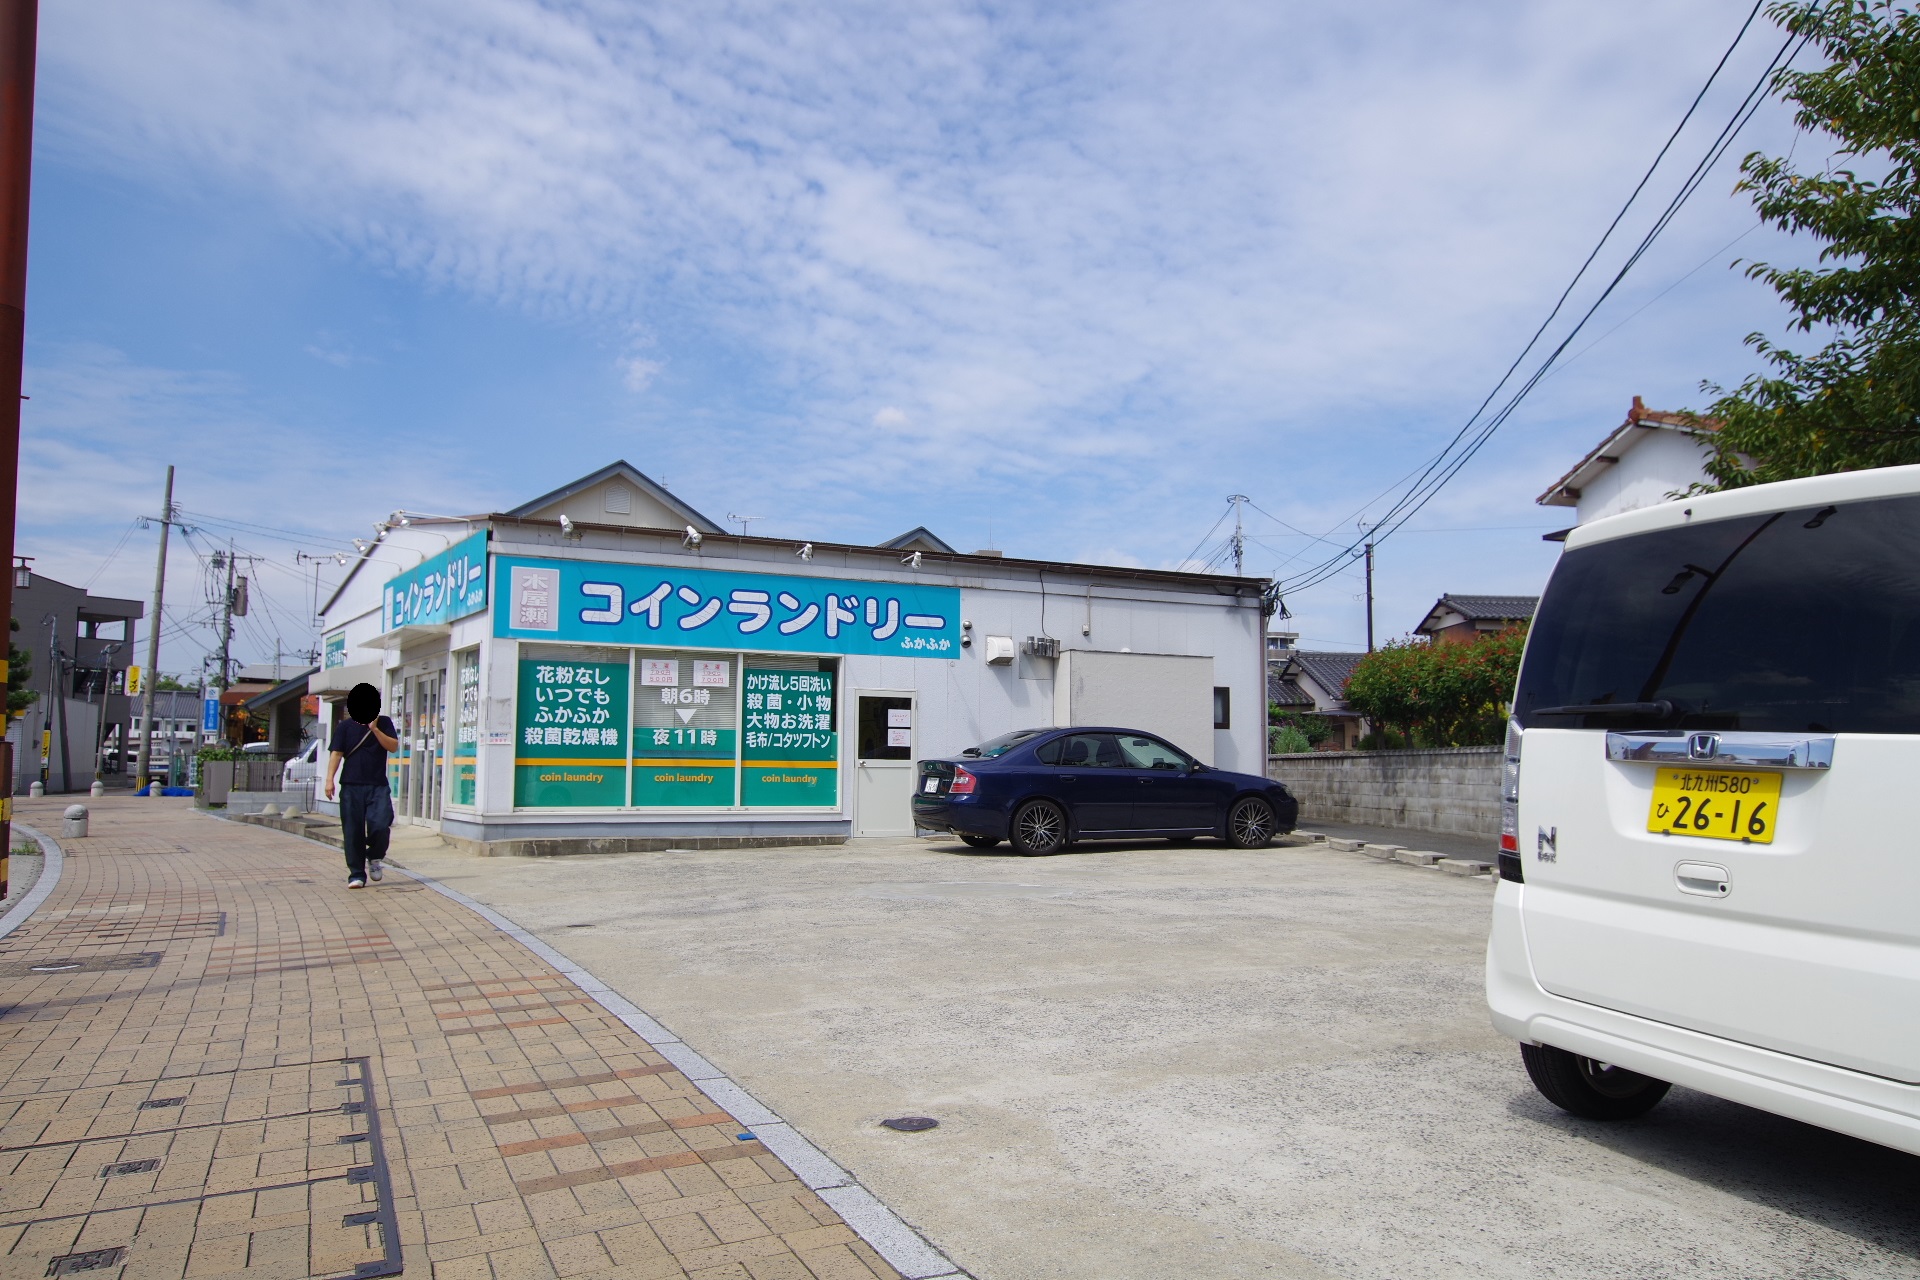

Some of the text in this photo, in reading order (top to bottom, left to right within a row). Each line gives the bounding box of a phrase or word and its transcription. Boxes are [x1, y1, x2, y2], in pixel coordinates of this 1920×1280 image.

[396, 554, 482, 627] コインランドリー
[520, 573, 548, 624] 木屋瀬
[579, 581, 946, 641] コインランドリー
[901, 636, 951, 651] ふかふか
[461, 666, 479, 685] 花粉なし
[535, 665, 610, 686] 花粉なし
[747, 674, 832, 693] かけ流し5回洗い
[460, 686, 478, 703] いつでも
[535, 687, 610, 705] いつでも
[661, 688, 711, 705] 朝6時
[746, 693, 831, 712] 殺菌・小物
[534, 706, 610, 724] ふかふか
[746, 712, 831, 731] 大物お洗濯
[524, 726, 618, 746] 殺菌乾燥機
[653, 728, 718, 746] 夜11時
[745, 731, 831, 749] 毛布/コタツフトン
[540, 772, 604, 784] coin laundry
[654, 772, 714, 784] coin laundry
[761, 774, 818, 785] coin laundry
[1657, 796, 1767, 835] ひ 26-16
[1538, 825, 1557, 852] N
